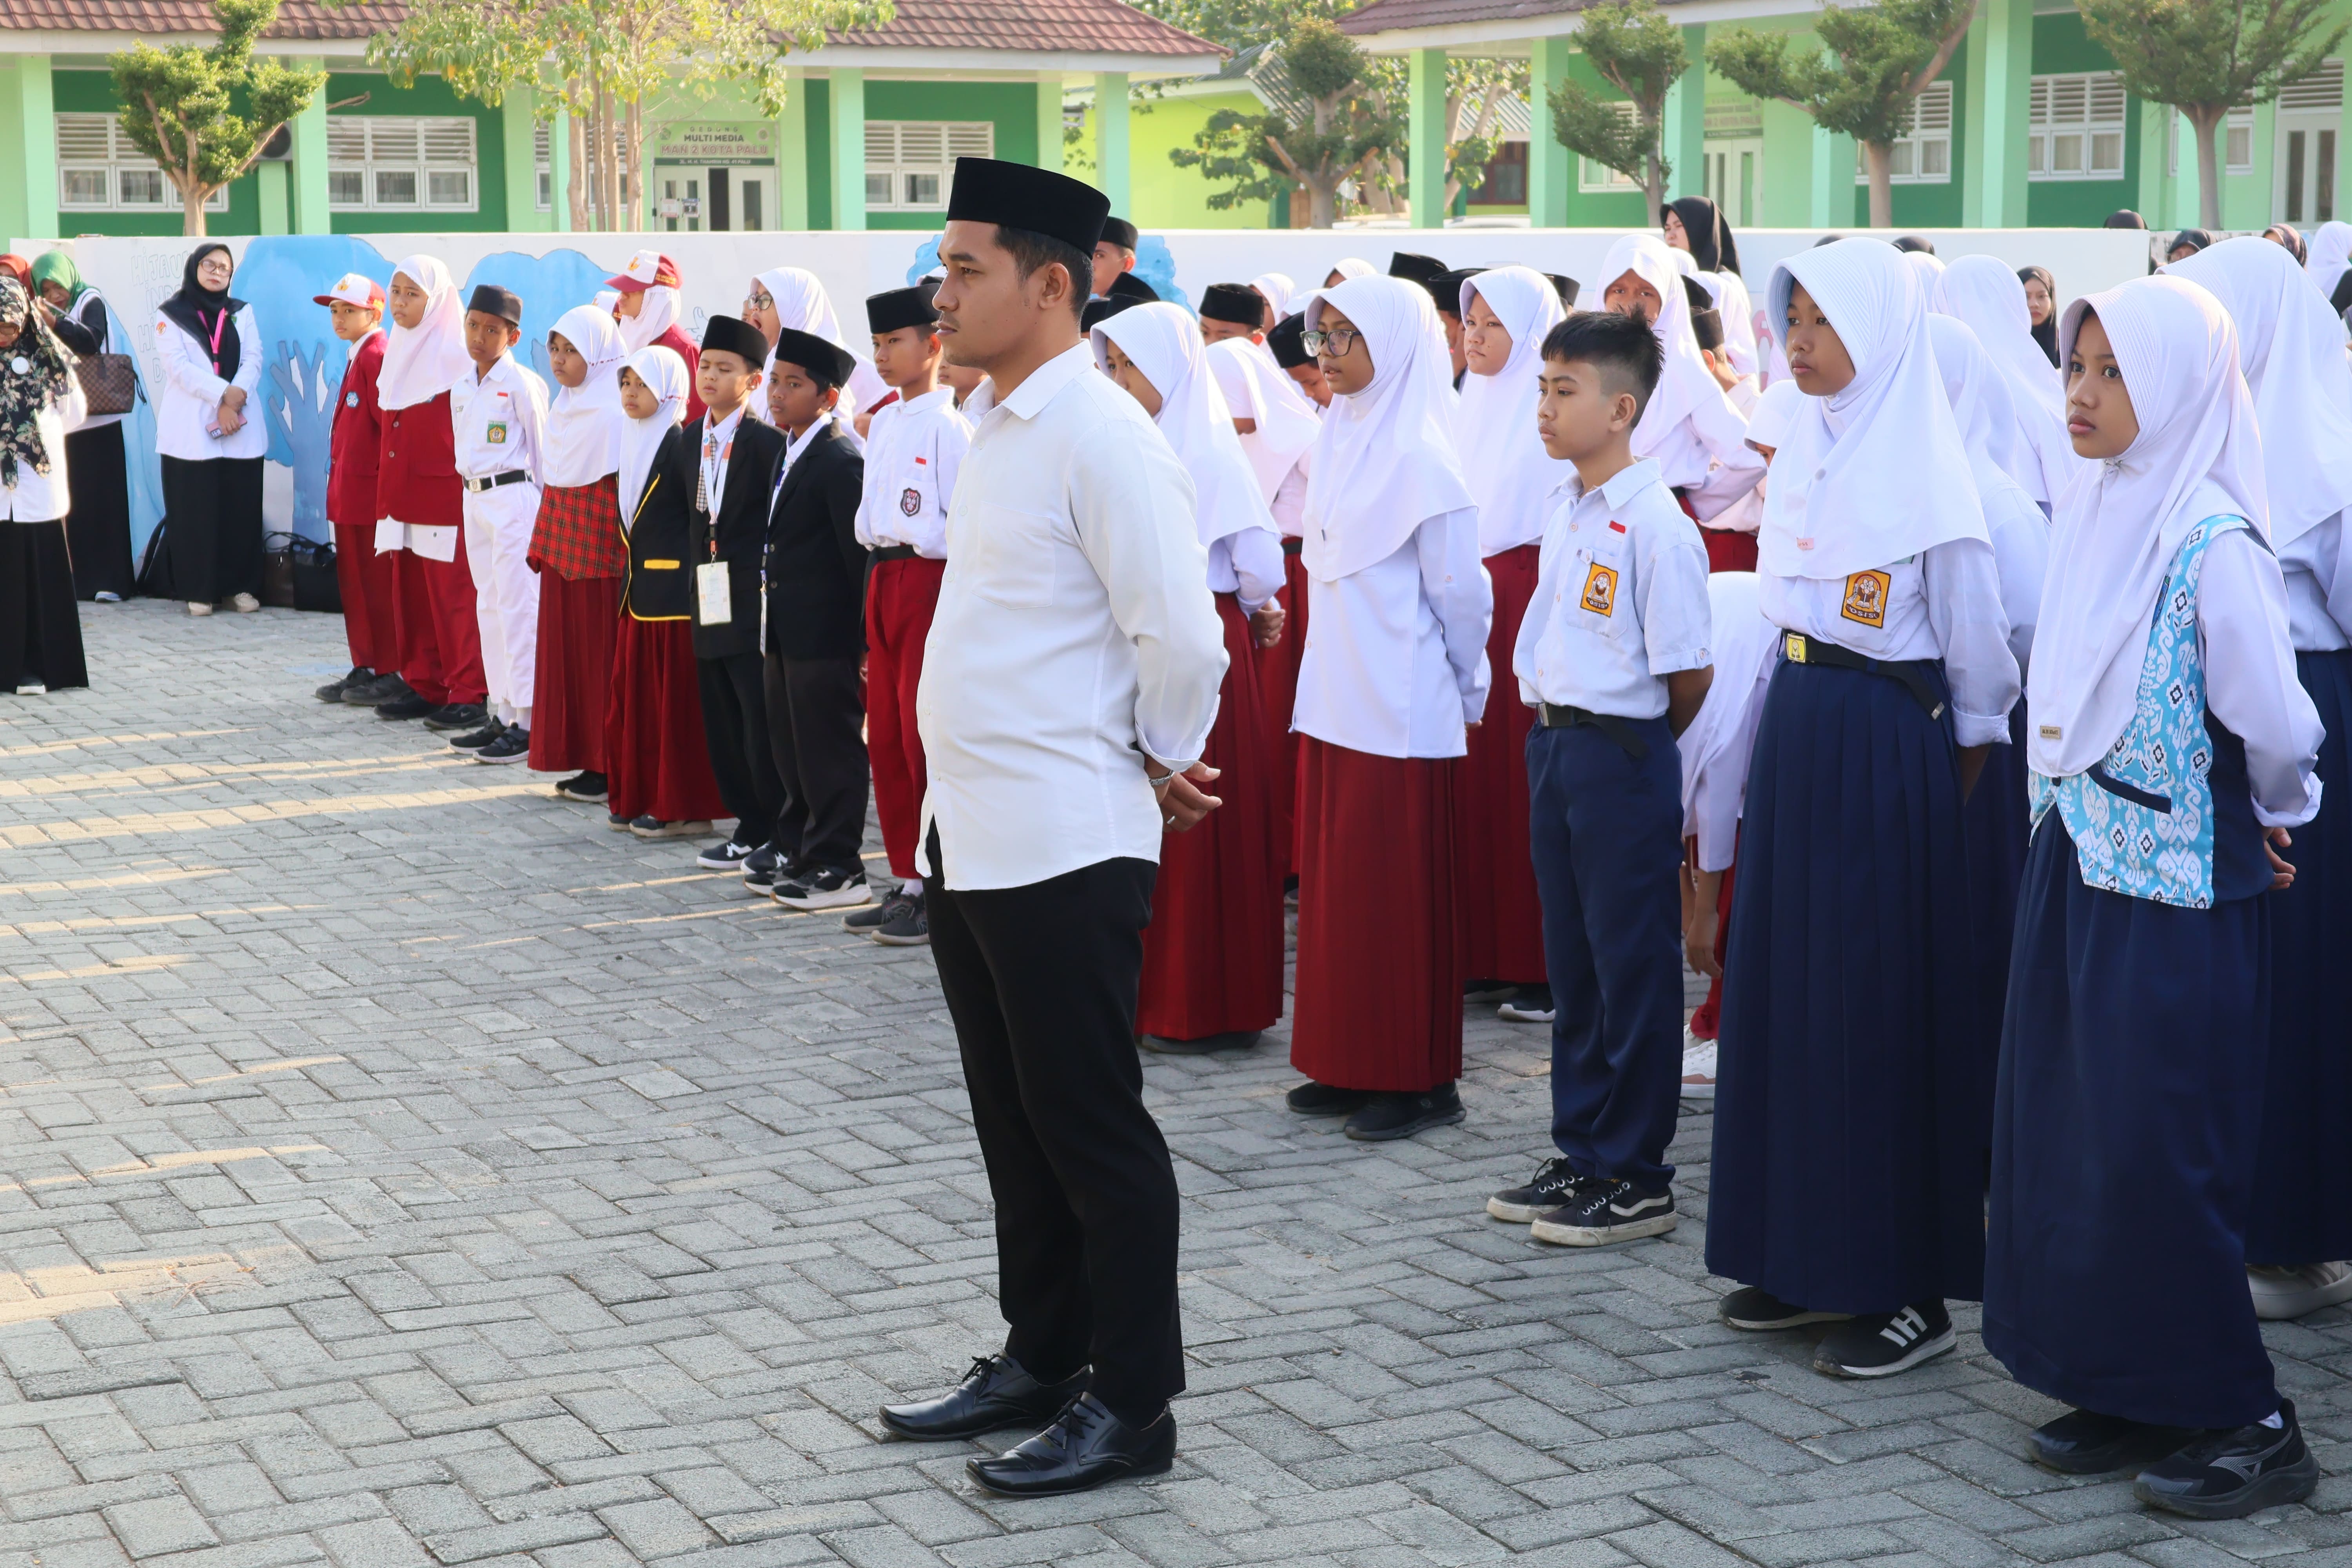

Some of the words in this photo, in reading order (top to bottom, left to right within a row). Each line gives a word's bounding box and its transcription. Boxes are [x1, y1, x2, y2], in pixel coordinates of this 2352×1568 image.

[661, 145, 688, 155] MAN
[691, 145, 699, 155] 2
[701, 145, 733, 155] KOTA
[737, 145, 767, 155] PALU
[1850, 608, 1874, 618] OSIS
